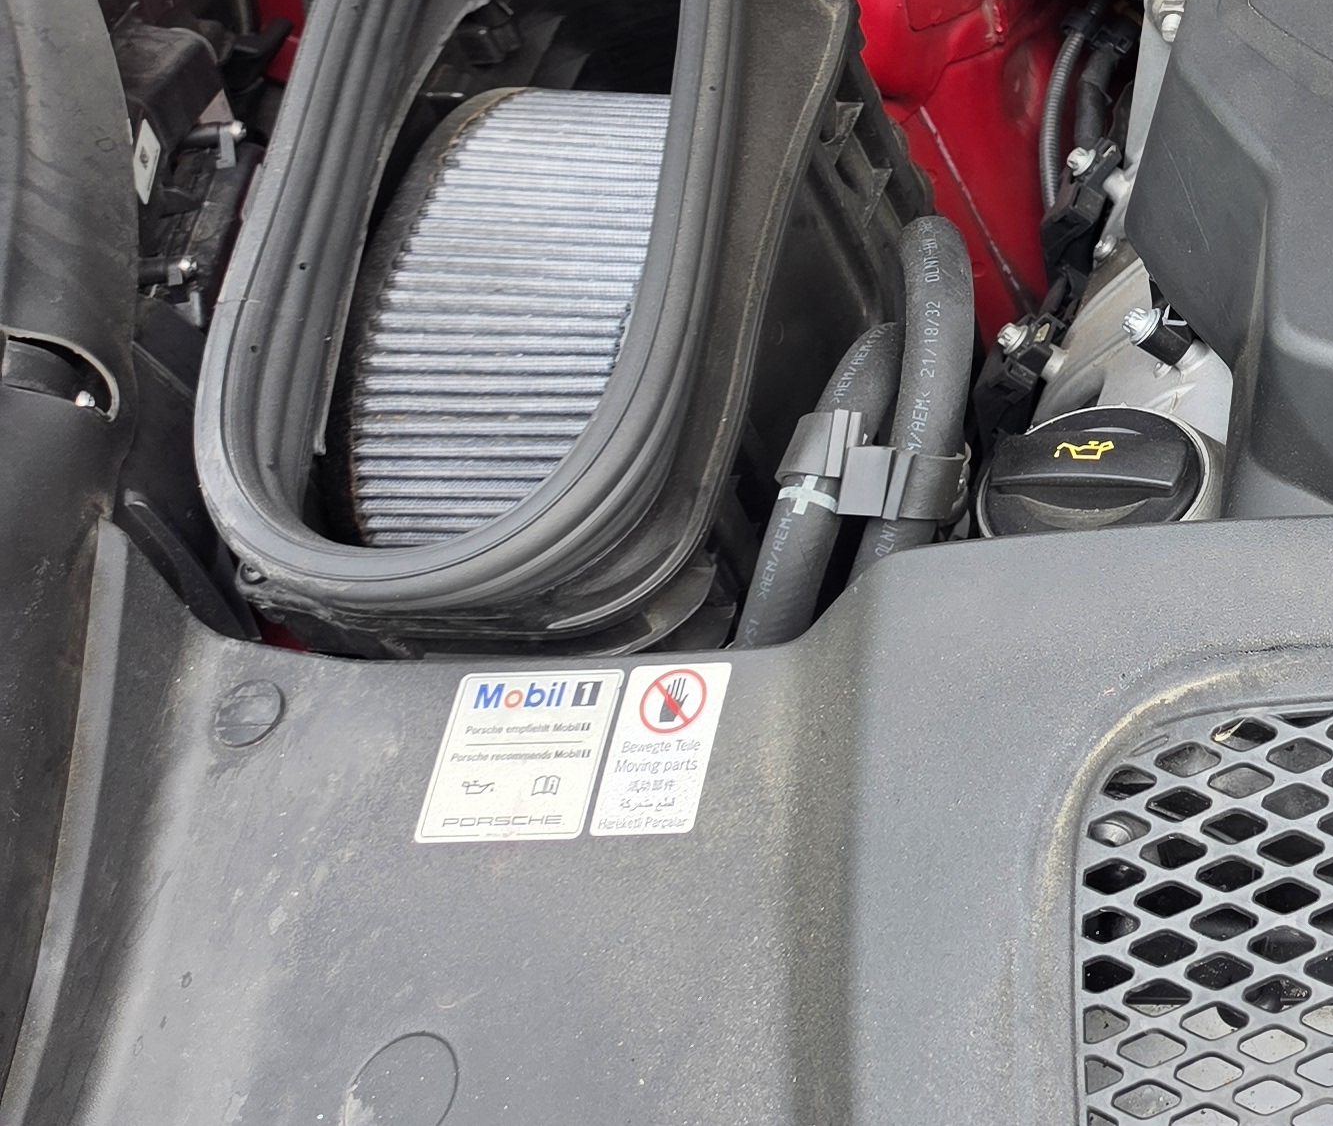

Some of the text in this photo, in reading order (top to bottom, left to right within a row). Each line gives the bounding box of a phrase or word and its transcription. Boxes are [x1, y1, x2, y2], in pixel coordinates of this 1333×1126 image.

[474, 682, 567, 709] Mobil
[465, 725, 504, 735] Porsche
[621, 738, 701, 754] Bewegte Teile
[450, 752, 489, 762] Porsche
[491, 750, 552, 761] recommends
[614, 758, 698, 774] Moving parts
[442, 814, 563, 828] PORSCHE
